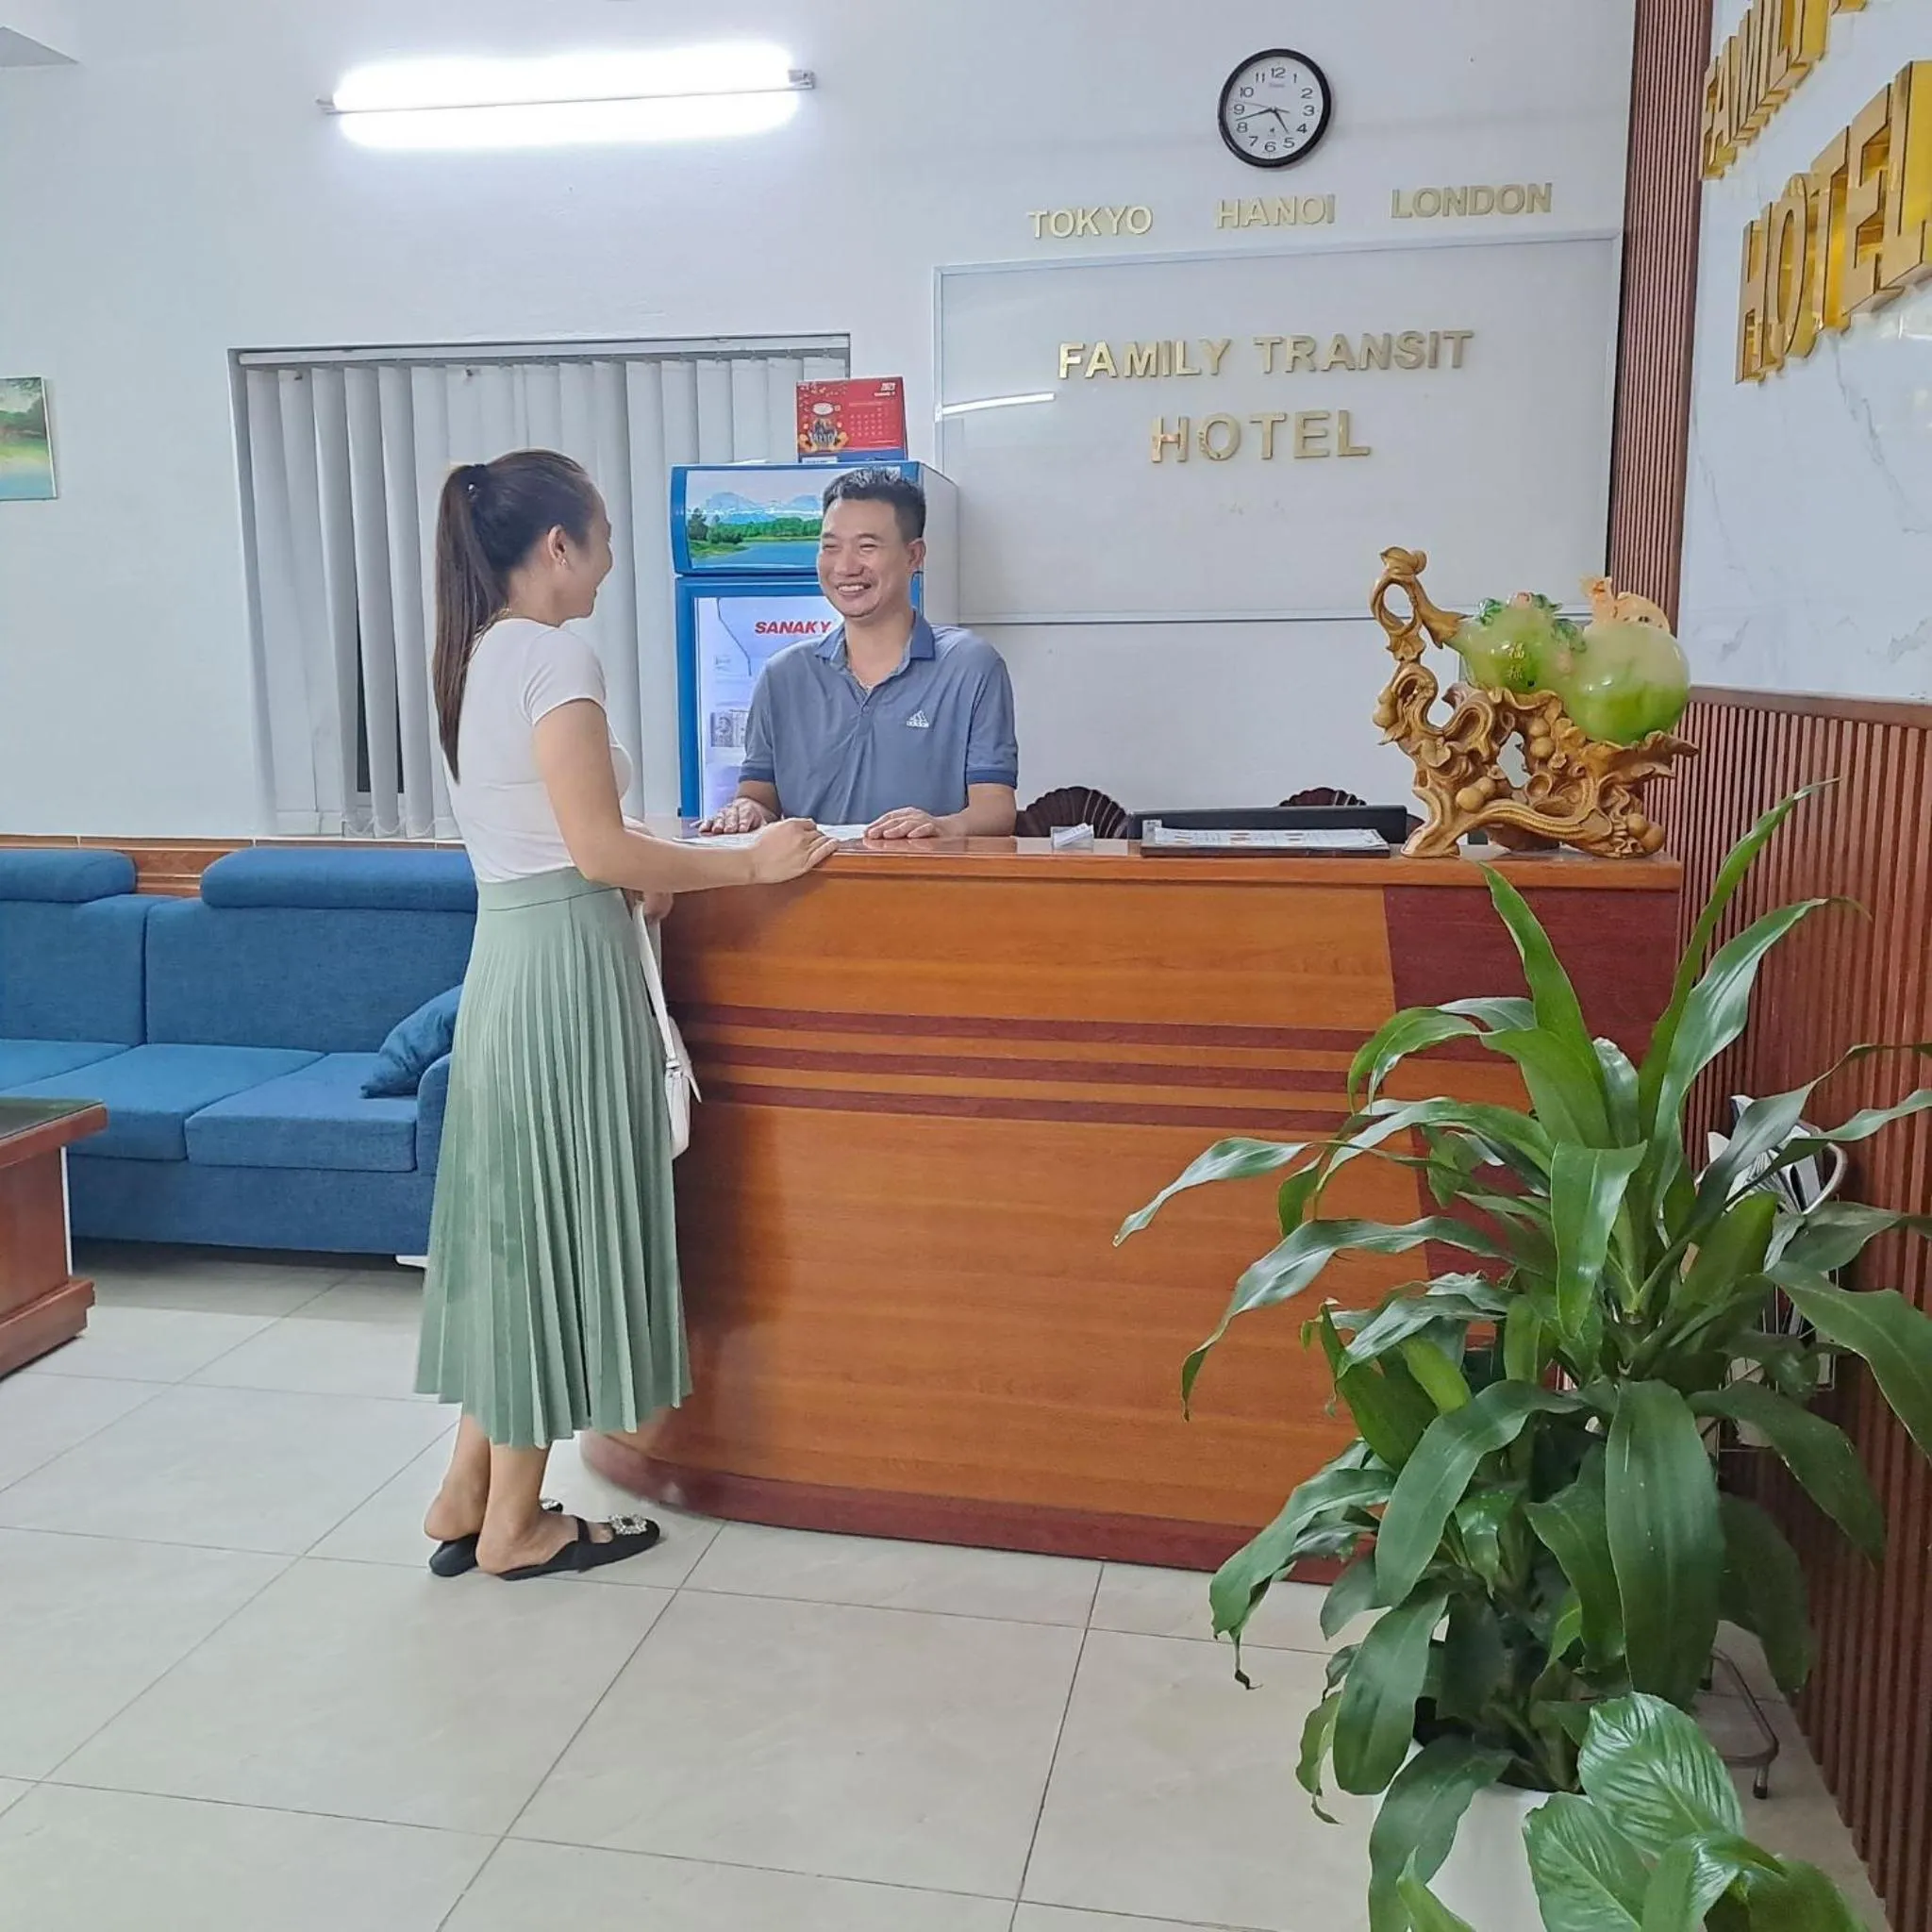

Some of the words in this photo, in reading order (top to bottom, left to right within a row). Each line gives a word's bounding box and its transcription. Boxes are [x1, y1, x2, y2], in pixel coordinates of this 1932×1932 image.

[1256, 73, 1265, 83] 11
[1271, 67, 1286, 78] 12
[1292, 74, 1298, 83] 1
[1240, 87, 1254, 98] 10
[1301, 88, 1313, 99] 2
[1233, 104, 1245, 115] 9
[1303, 105, 1315, 116] 3
[1237, 122, 1248, 133] 8
[1296, 124, 1307, 134] 4
[1249, 136, 1258, 146] 7
[1283, 137, 1295, 148] 5
[1264, 142, 1276, 152] 6
[1027, 205, 1153, 239] TOKYO
[1216, 194, 1336, 228] HANOI
[1391, 182, 1553, 219] LONDON
[1058, 338, 1230, 379] FAMILY
[1254, 329, 1474, 375] TRANSIT
[1150, 408, 1372, 463] HOTEL
[755, 621, 832, 634] SANAKY
